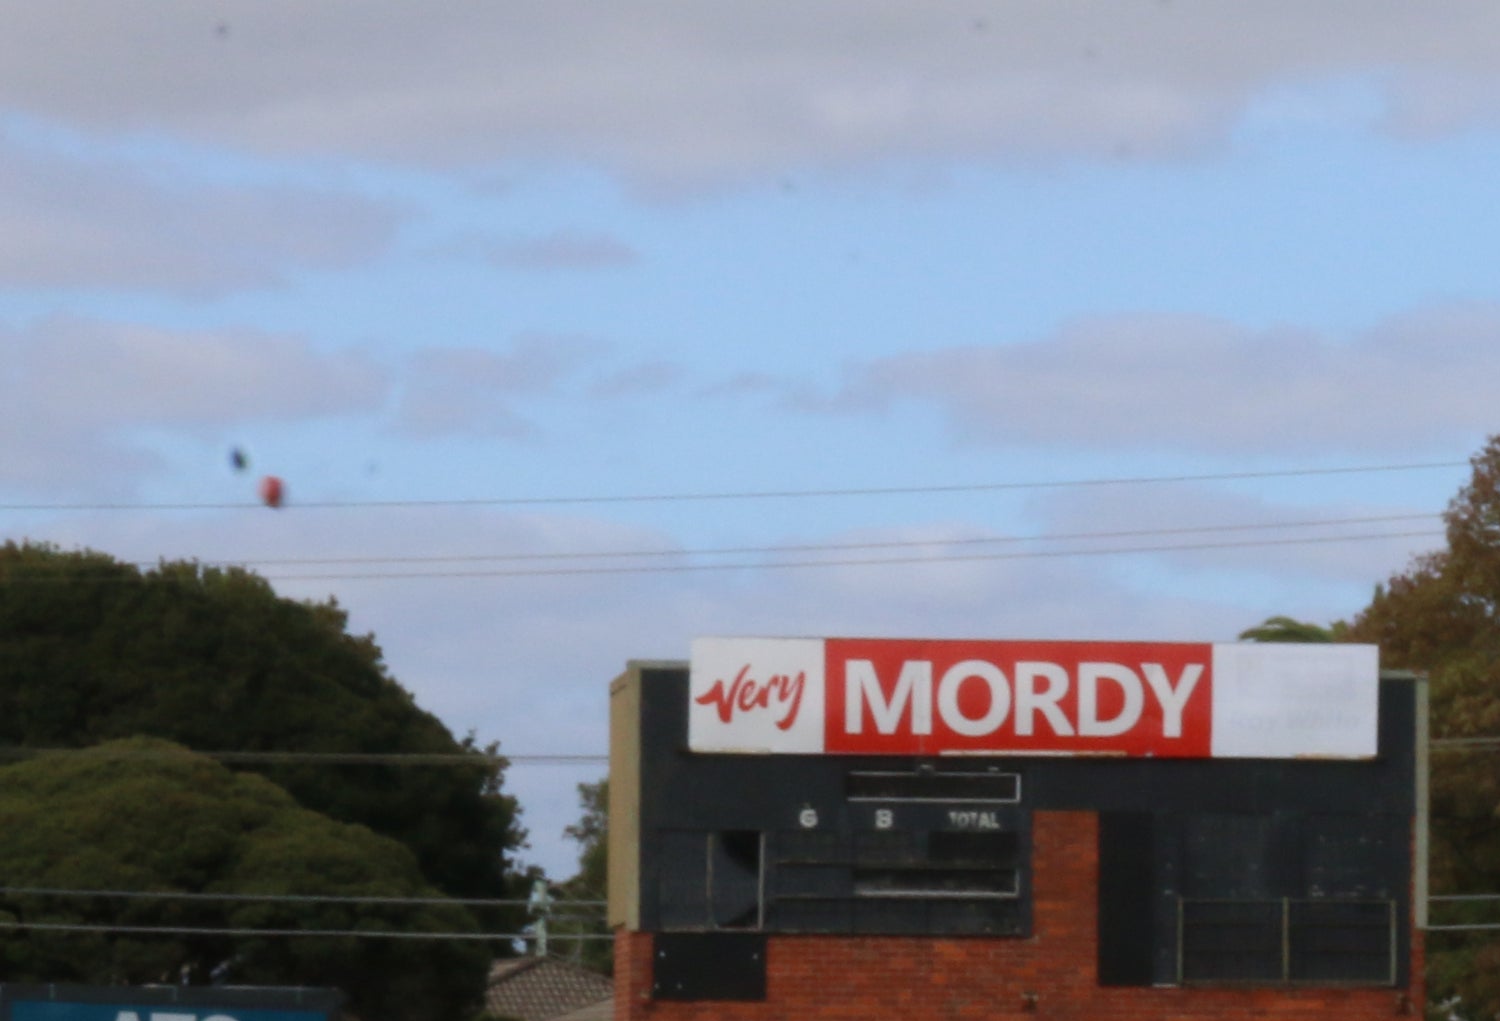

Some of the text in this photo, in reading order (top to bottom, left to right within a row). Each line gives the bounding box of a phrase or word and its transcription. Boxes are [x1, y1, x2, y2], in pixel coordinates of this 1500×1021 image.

[695, 659, 1205, 738] Very MORDY
[949, 811, 1000, 828] TOTAL
